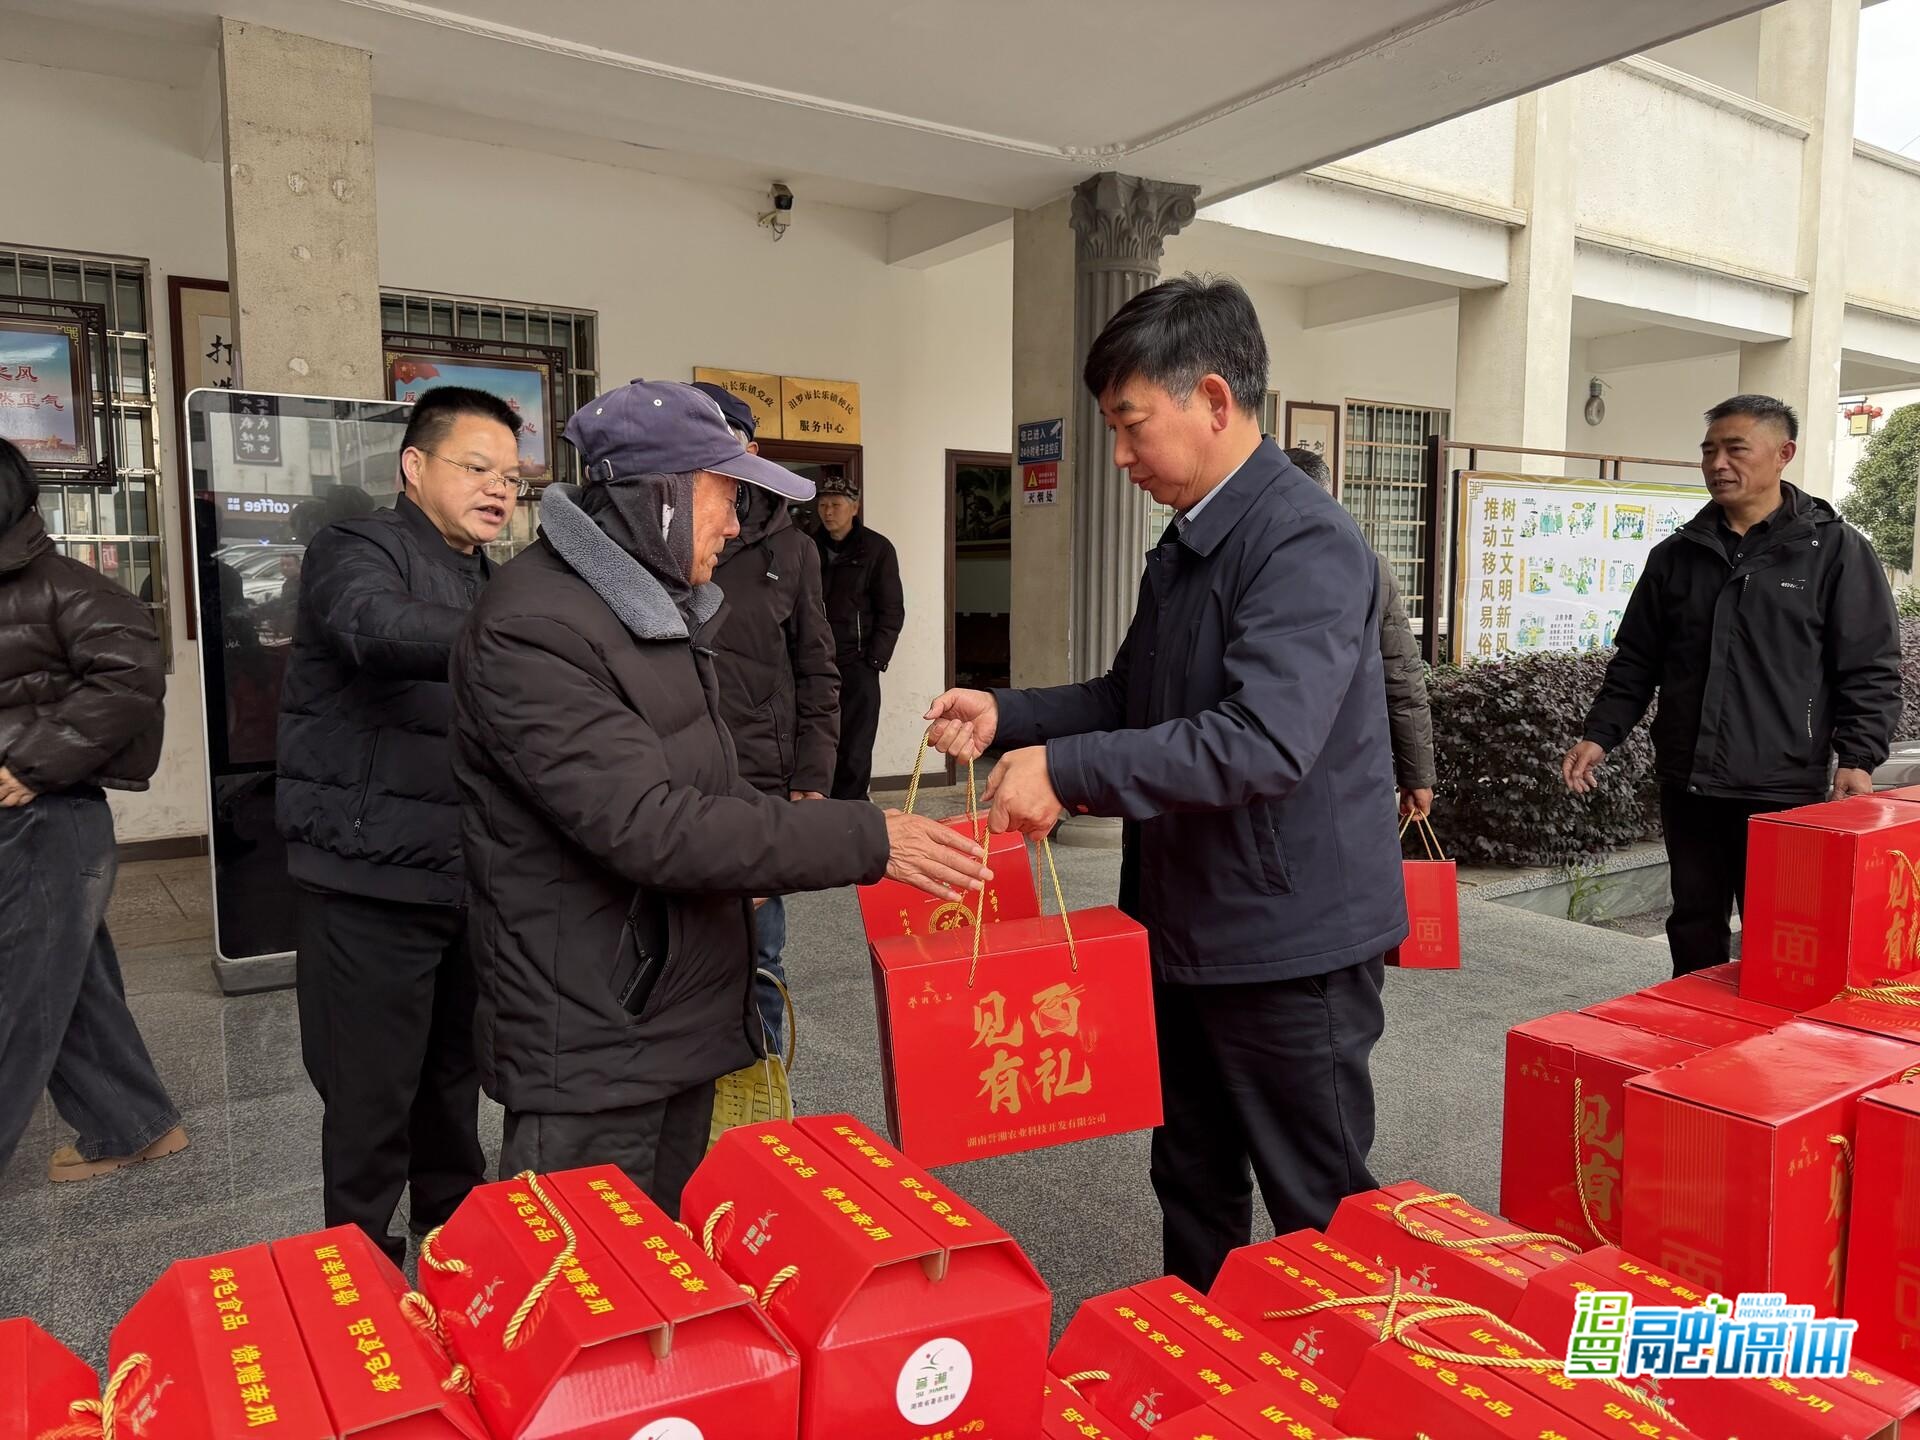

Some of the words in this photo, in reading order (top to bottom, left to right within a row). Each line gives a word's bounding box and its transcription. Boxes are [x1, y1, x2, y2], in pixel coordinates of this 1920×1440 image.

[799, 419, 845, 434] 服务中心
[1477, 496, 1500, 656] 推动移风易俗
[1495, 497, 1517, 652] 树立文明新风
[975, 1047, 1093, 1114] 有礼
[757, 1133, 820, 1180] 绿色食品
[507, 1186, 561, 1244] 绿色食品
[642, 1234, 711, 1294] 绿色食品
[207, 1265, 250, 1332] 绿色食品
[346, 1316, 403, 1394] 绿色食品
[1114, 1304, 1186, 1359] 绿色食品
[1258, 1350, 1342, 1410] 绿色食品
[1407, 1353, 1515, 1419] 绿色食品
